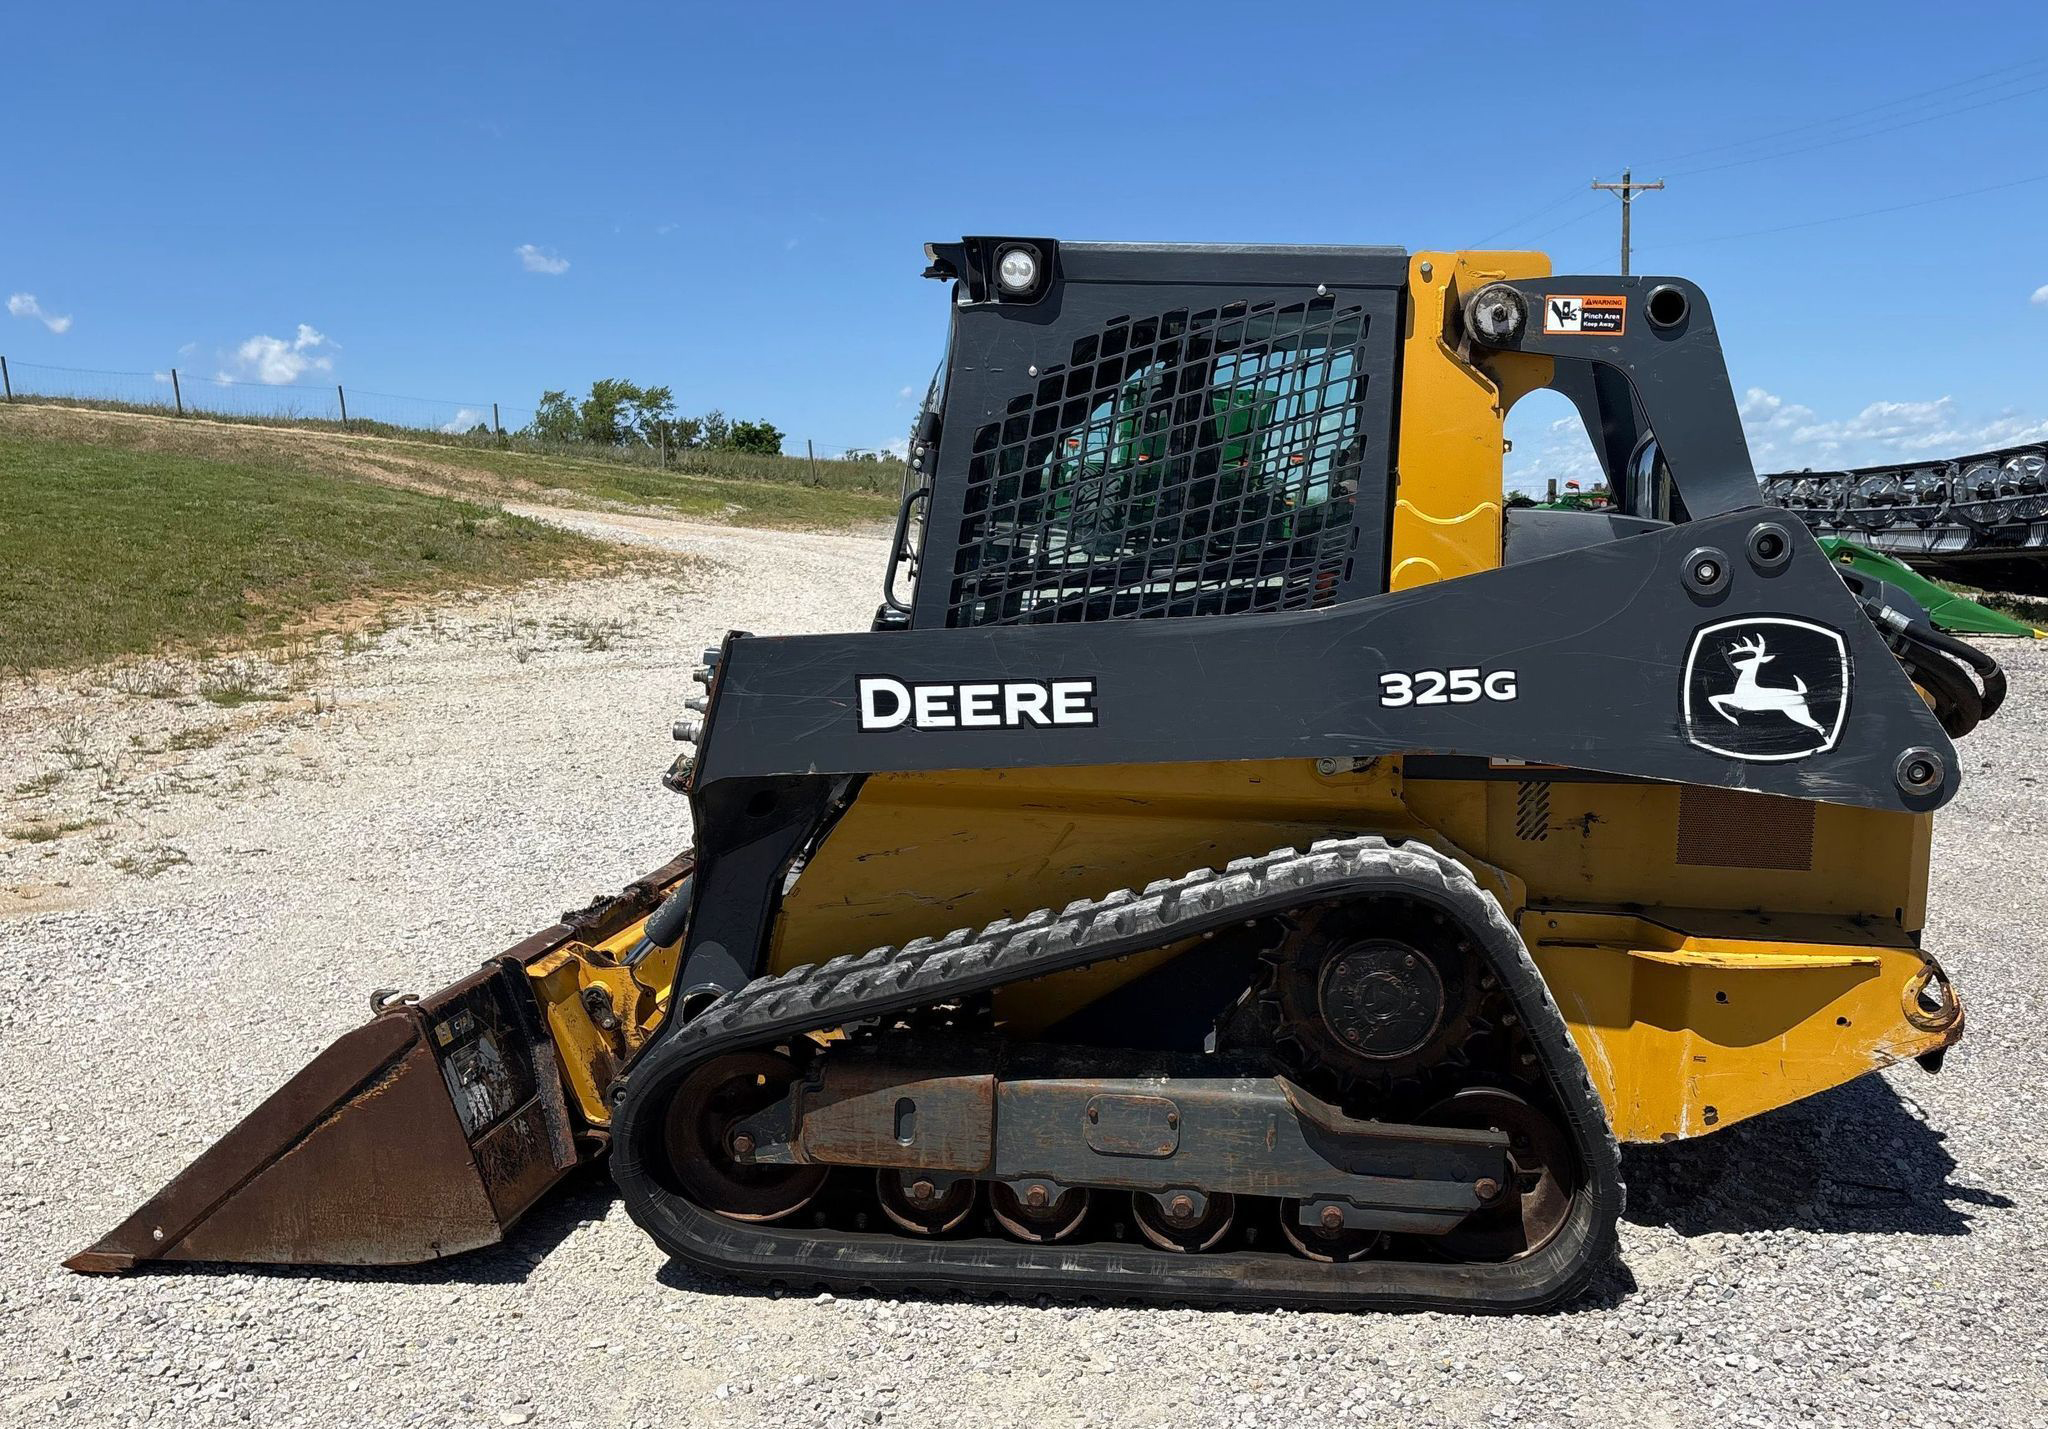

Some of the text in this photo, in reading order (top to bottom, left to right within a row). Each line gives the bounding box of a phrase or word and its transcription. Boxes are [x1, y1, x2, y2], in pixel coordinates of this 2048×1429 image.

[1583, 312, 1603, 320] Pinch
[1599, 321, 1615, 329] Away
[1379, 668, 1517, 707] 325G
[859, 678, 1095, 729] DEERE
